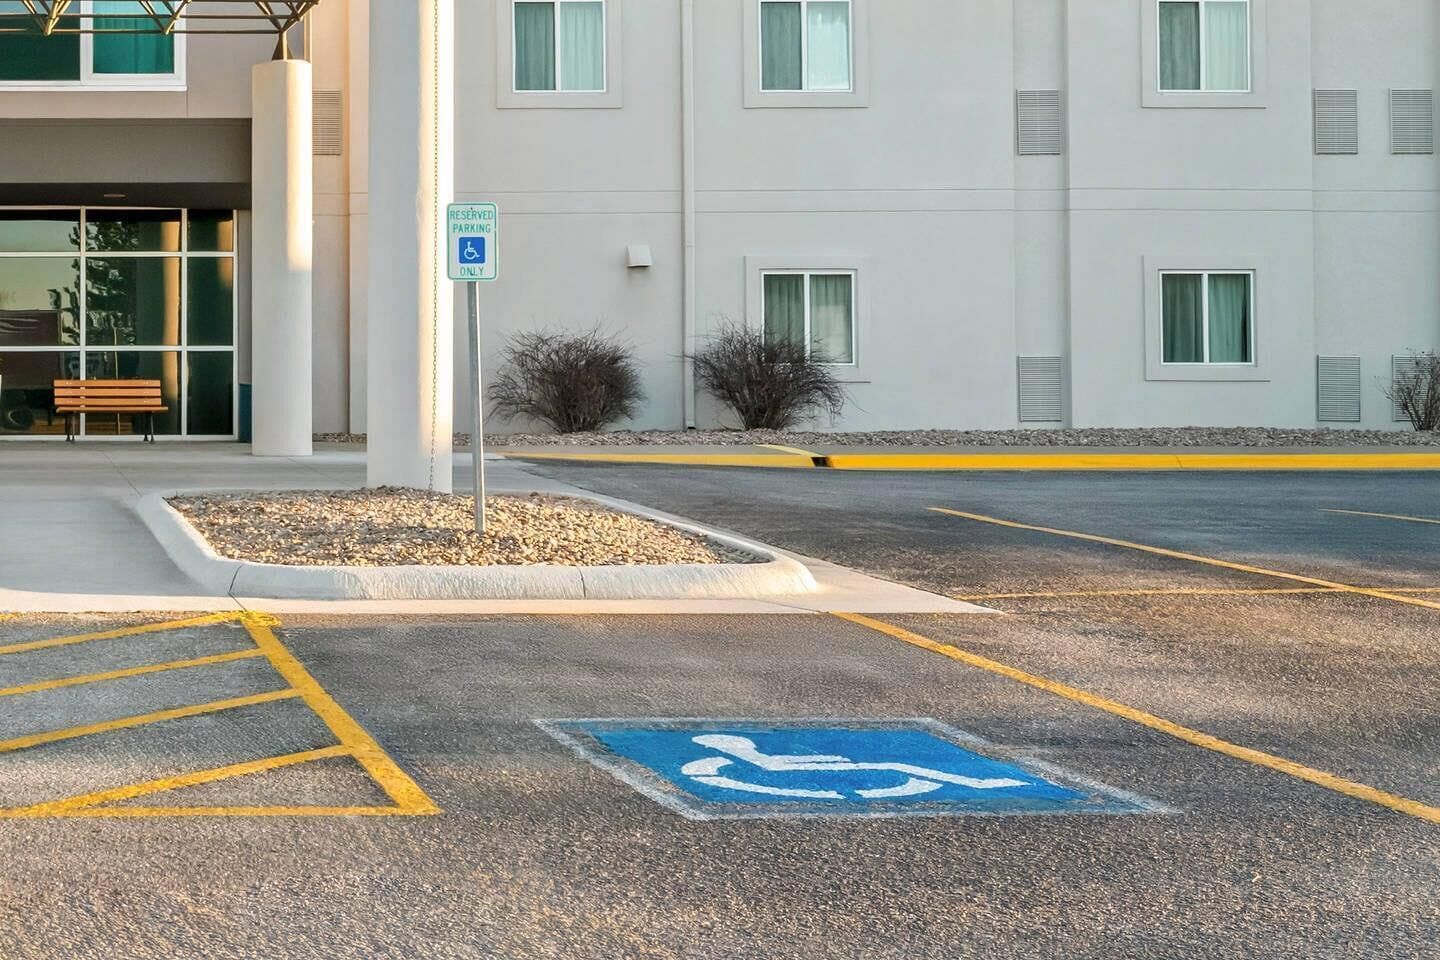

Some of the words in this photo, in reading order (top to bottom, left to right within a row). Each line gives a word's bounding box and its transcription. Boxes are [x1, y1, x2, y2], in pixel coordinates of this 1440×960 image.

[449, 210, 493, 220] RESERVED
[453, 223, 491, 233] PARKING
[460, 266, 484, 276] ONLY
